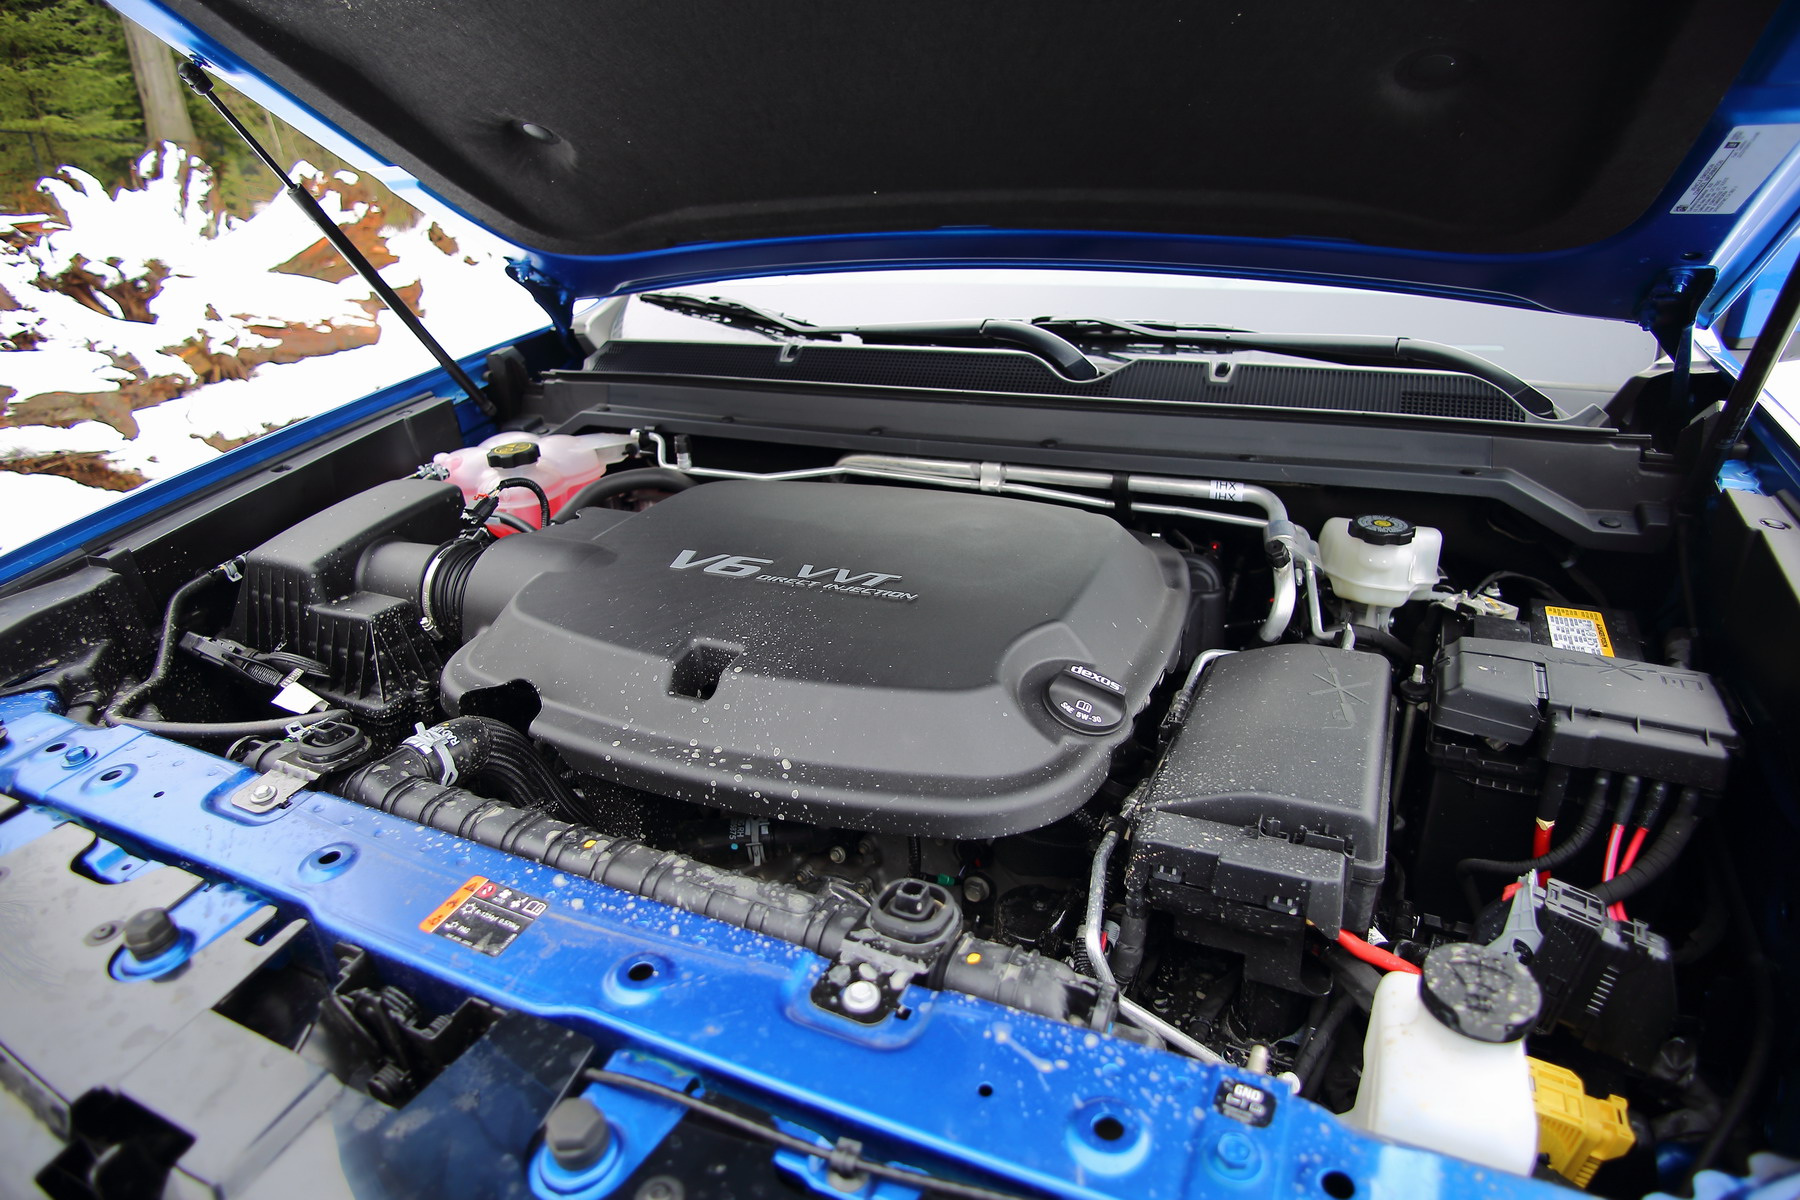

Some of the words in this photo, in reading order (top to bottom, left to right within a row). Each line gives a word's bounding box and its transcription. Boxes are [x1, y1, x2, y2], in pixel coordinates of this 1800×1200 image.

[1215, 480, 1237, 490] IHX
[669, 549, 774, 577] V6
[797, 564, 902, 587] VVT
[755, 574, 821, 588] DIRECT
[822, 582, 919, 600] INJECTION
[1070, 665, 1122, 691] dexos
[1060, 701, 1075, 714] SAE
[1076, 711, 1102, 723] 5W-30
